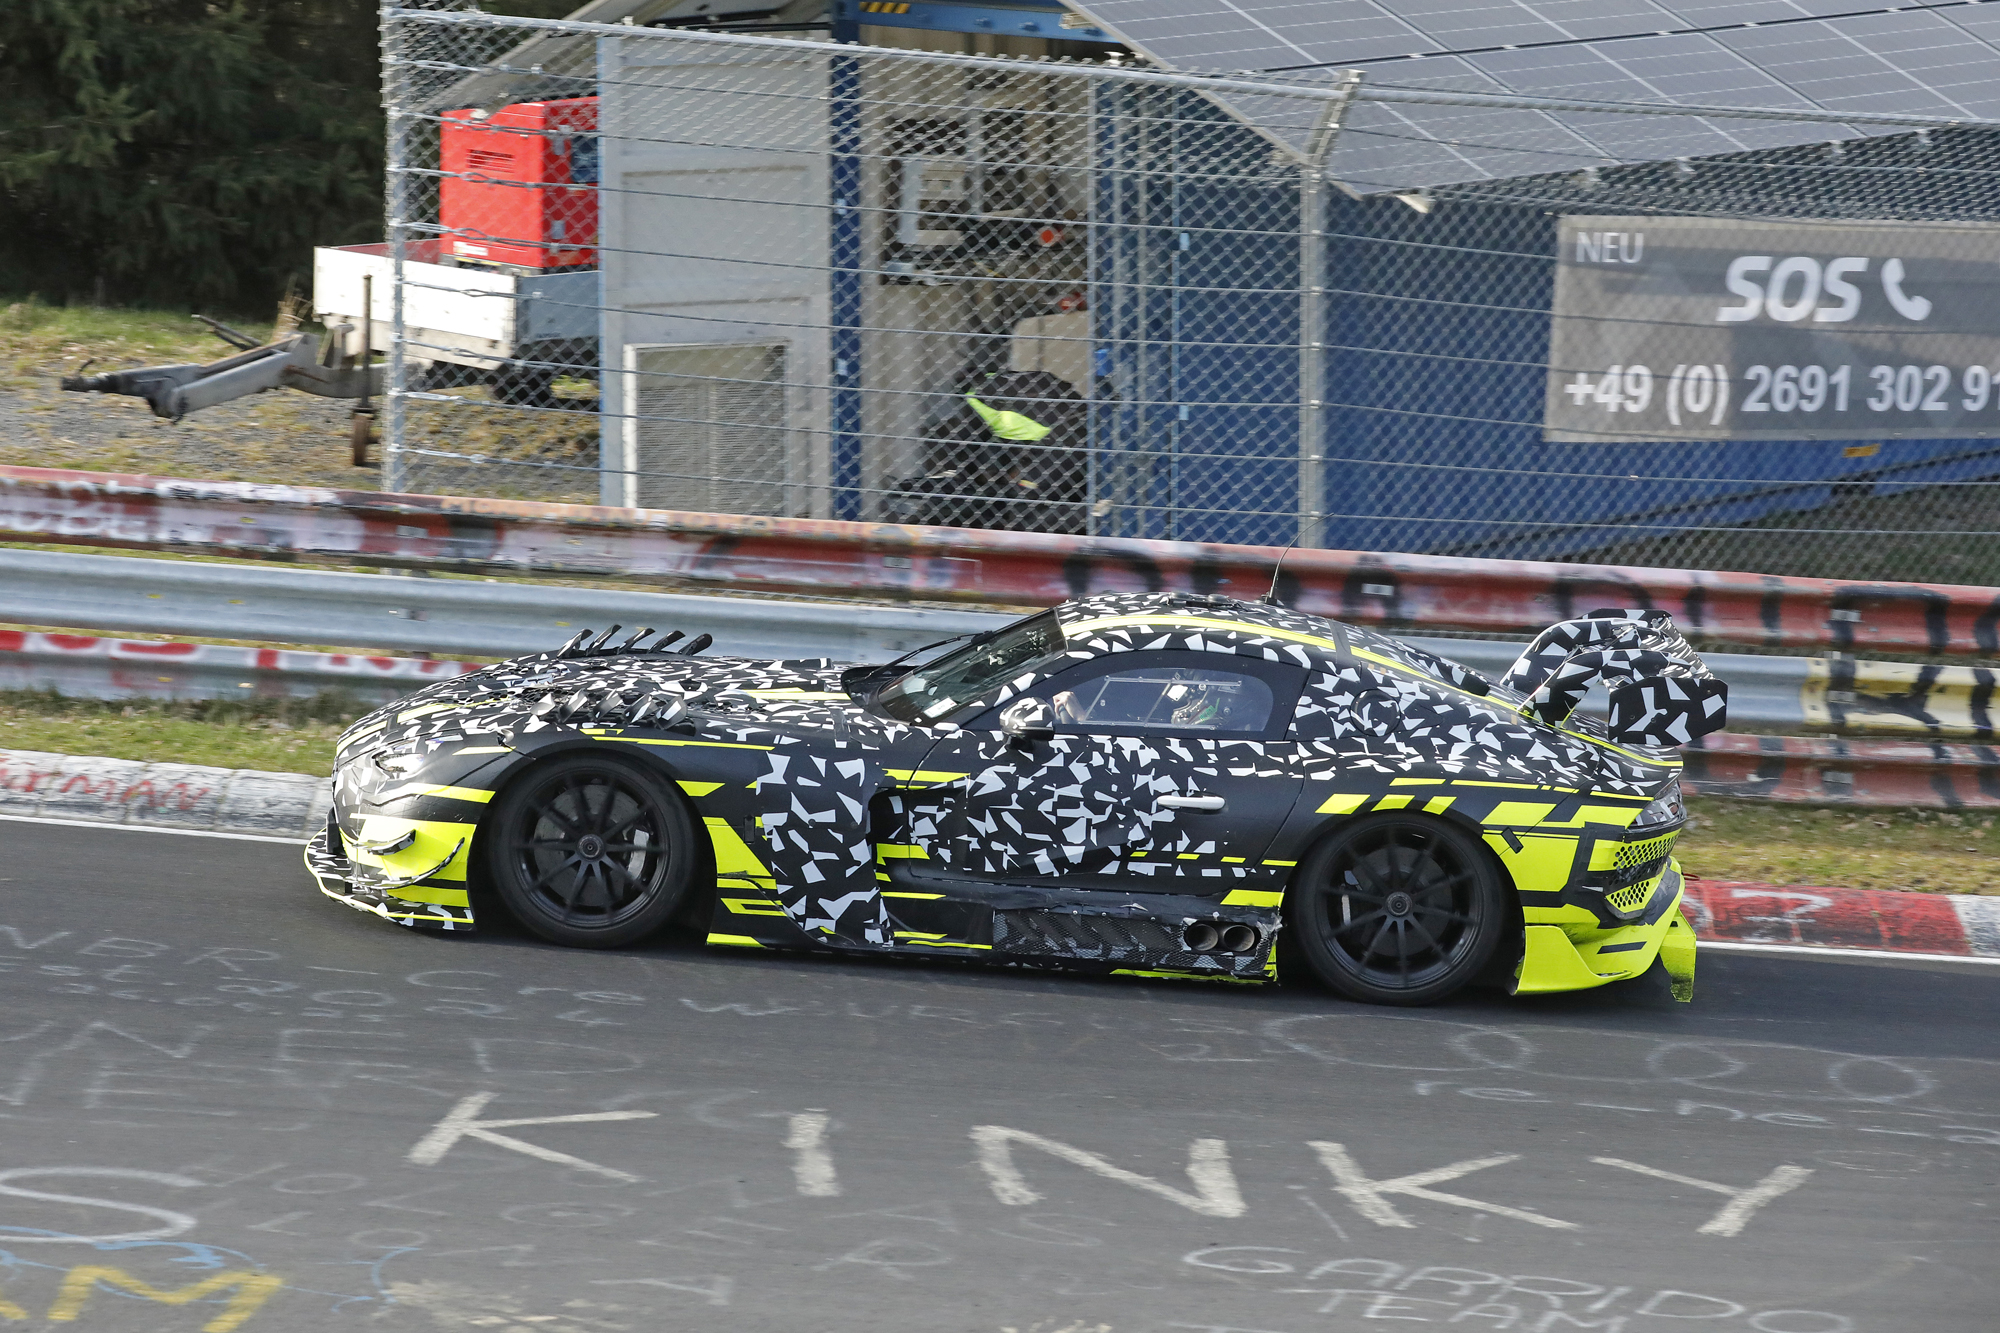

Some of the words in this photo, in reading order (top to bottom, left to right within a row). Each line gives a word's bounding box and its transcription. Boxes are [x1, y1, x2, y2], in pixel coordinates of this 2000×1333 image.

[1576, 231, 1644, 263] NEU
[1715, 256, 1869, 322] SOS
[1564, 363, 1654, 413] +49
[1665, 363, 1730, 426] (0)
[1741, 364, 1852, 412] 2691
[1866, 364, 1951, 412] 302
[405, 1092, 1814, 1238] KINKY
[1182, 1245, 1855, 1333] GARRIDO
